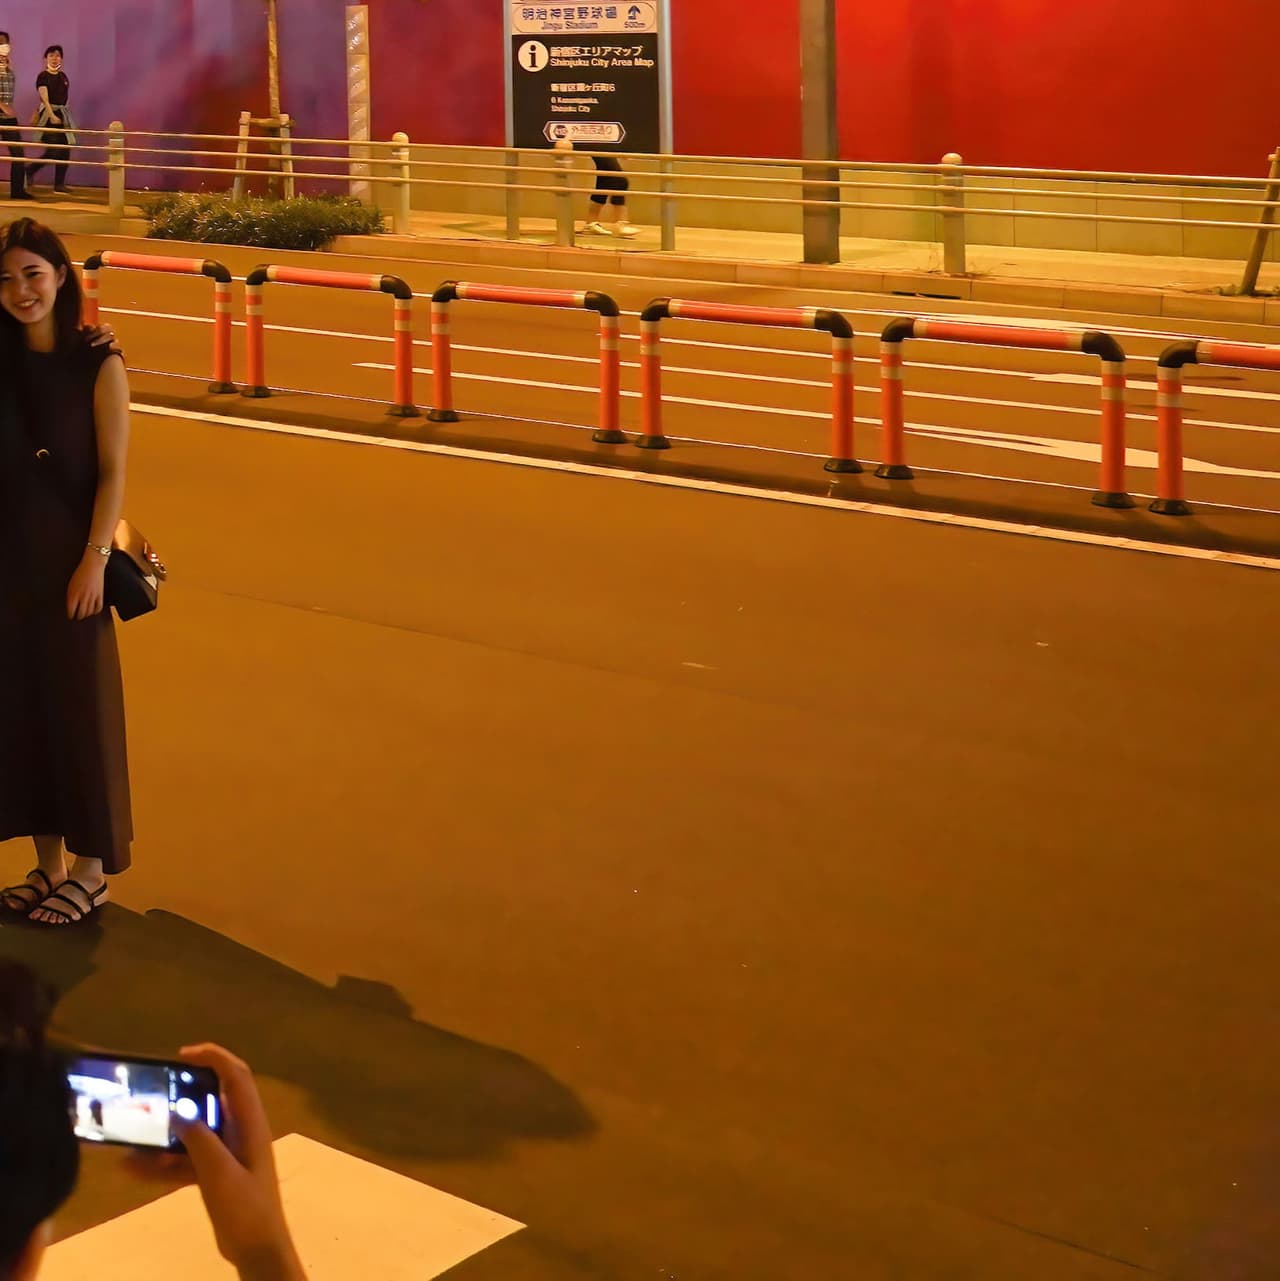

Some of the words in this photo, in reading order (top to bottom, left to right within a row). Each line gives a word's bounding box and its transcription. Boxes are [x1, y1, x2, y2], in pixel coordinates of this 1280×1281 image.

[565, 21, 598, 29] Stadium
[550, 58, 589, 68] Shinjuku
[591, 58, 609, 68] City
[611, 58, 632, 66] Area
[634, 58, 654, 68] Map
